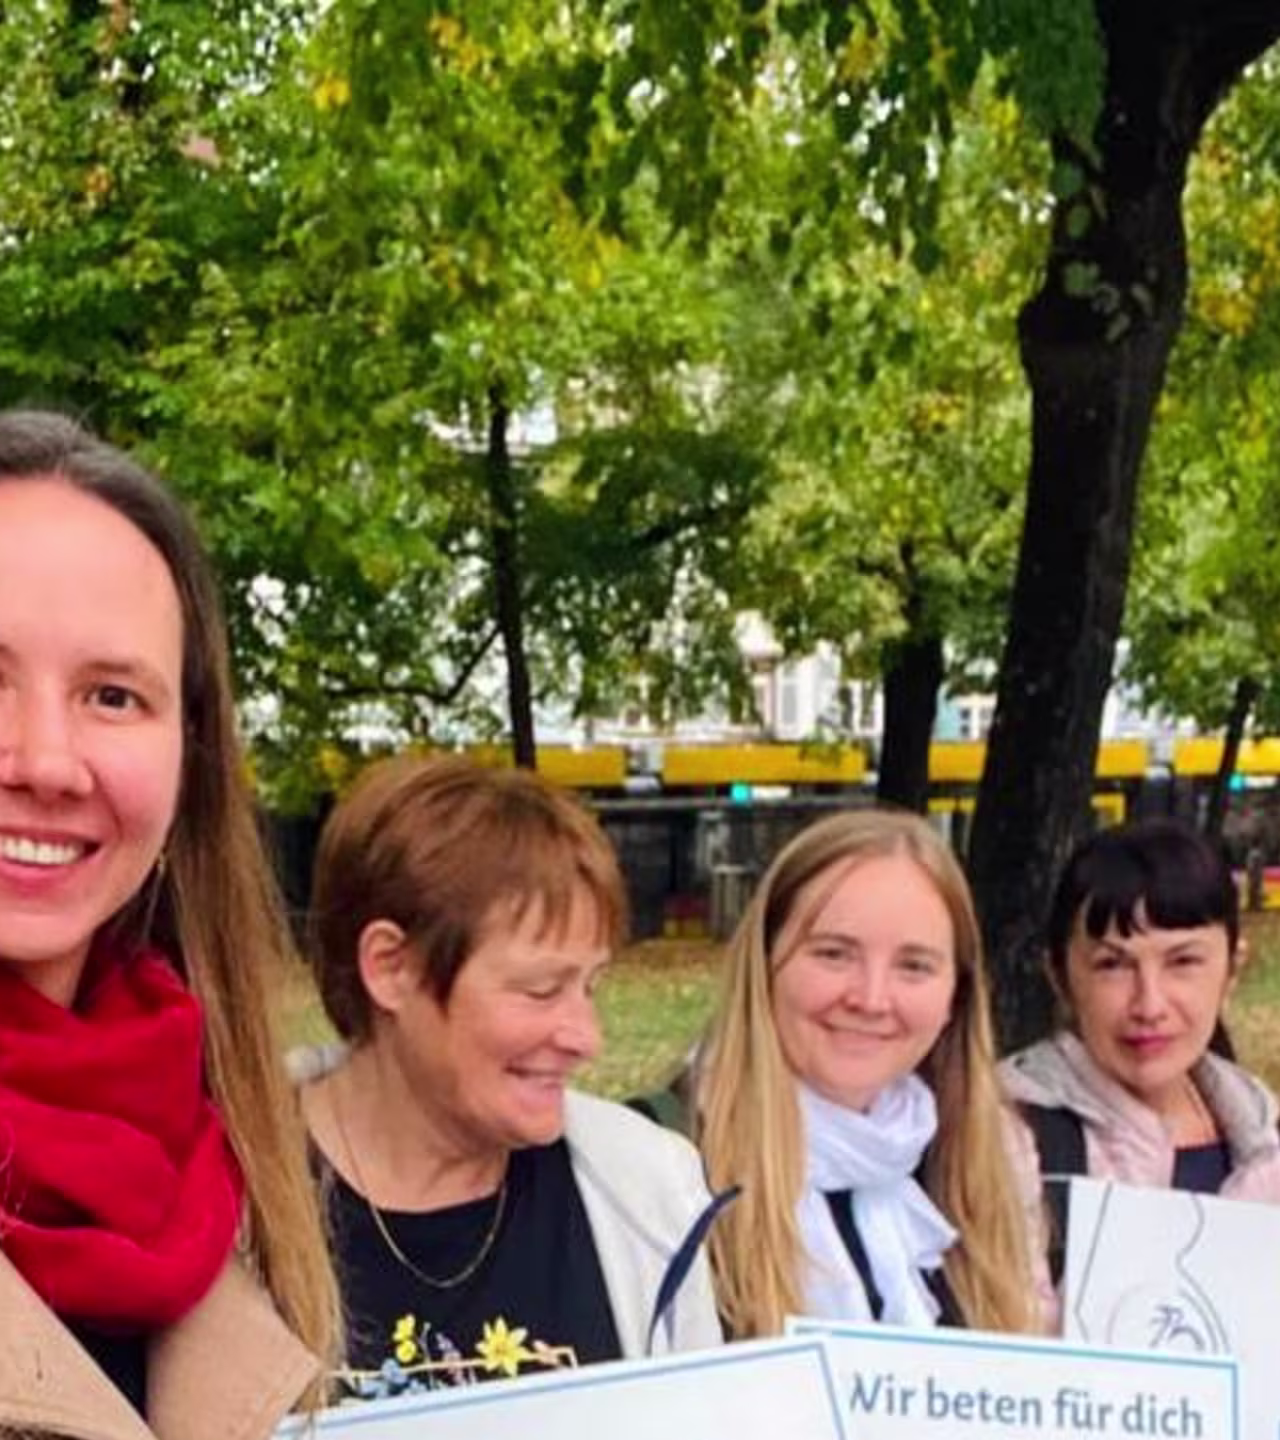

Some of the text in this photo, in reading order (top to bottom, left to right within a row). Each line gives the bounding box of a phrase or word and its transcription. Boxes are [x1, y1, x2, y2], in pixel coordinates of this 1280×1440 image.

[926, 1376, 1043, 1428] beten
[1052, 1387, 1113, 1432] für
[1121, 1392, 1203, 1439] dich
